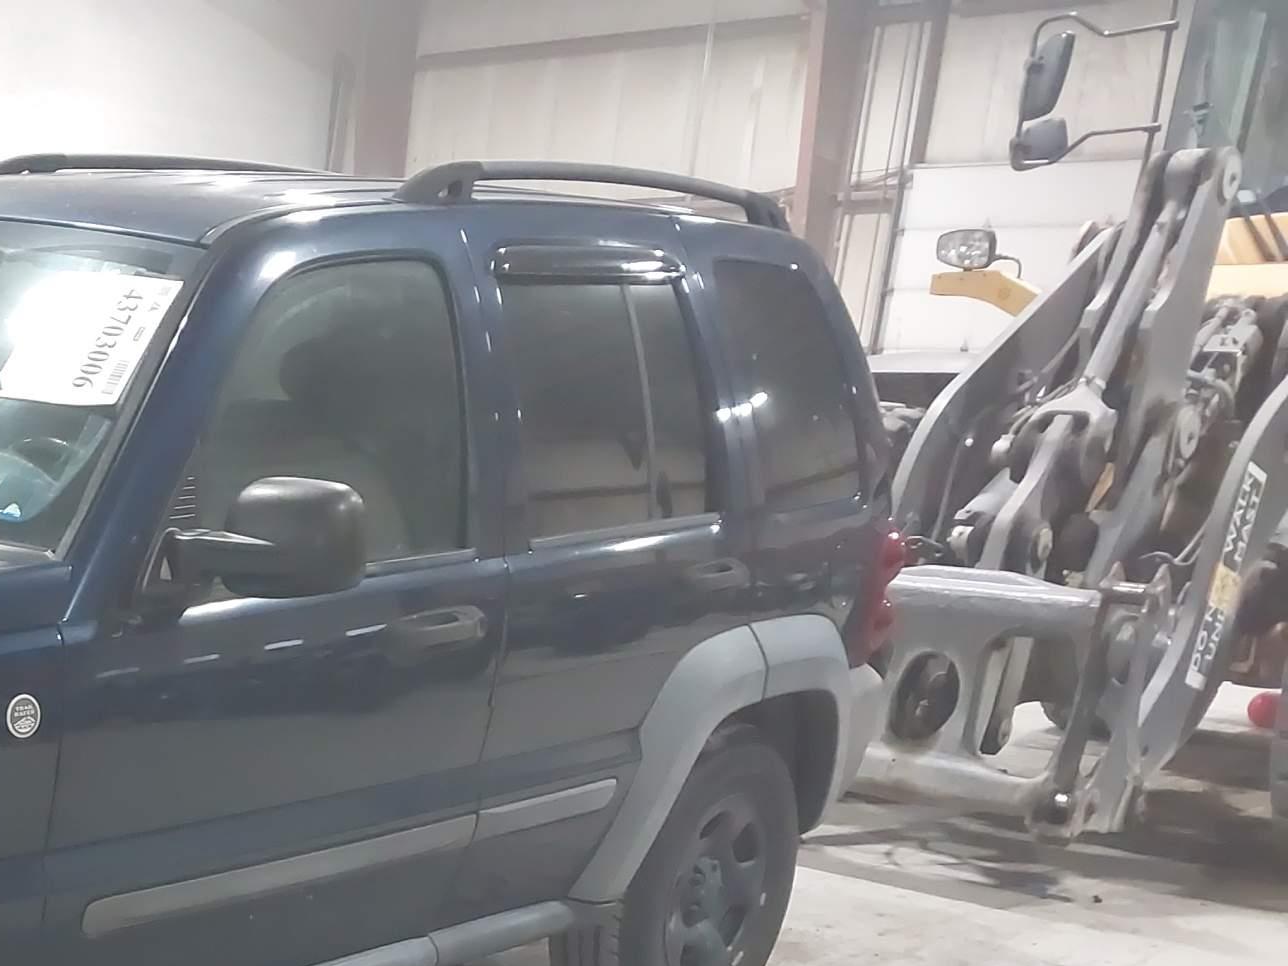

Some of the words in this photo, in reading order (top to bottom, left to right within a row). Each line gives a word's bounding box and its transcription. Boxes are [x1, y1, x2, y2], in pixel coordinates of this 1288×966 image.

[72, 289, 144, 388] 43703006
[1223, 475, 1255, 553] WALK
[1233, 488, 1260, 561] MAST
